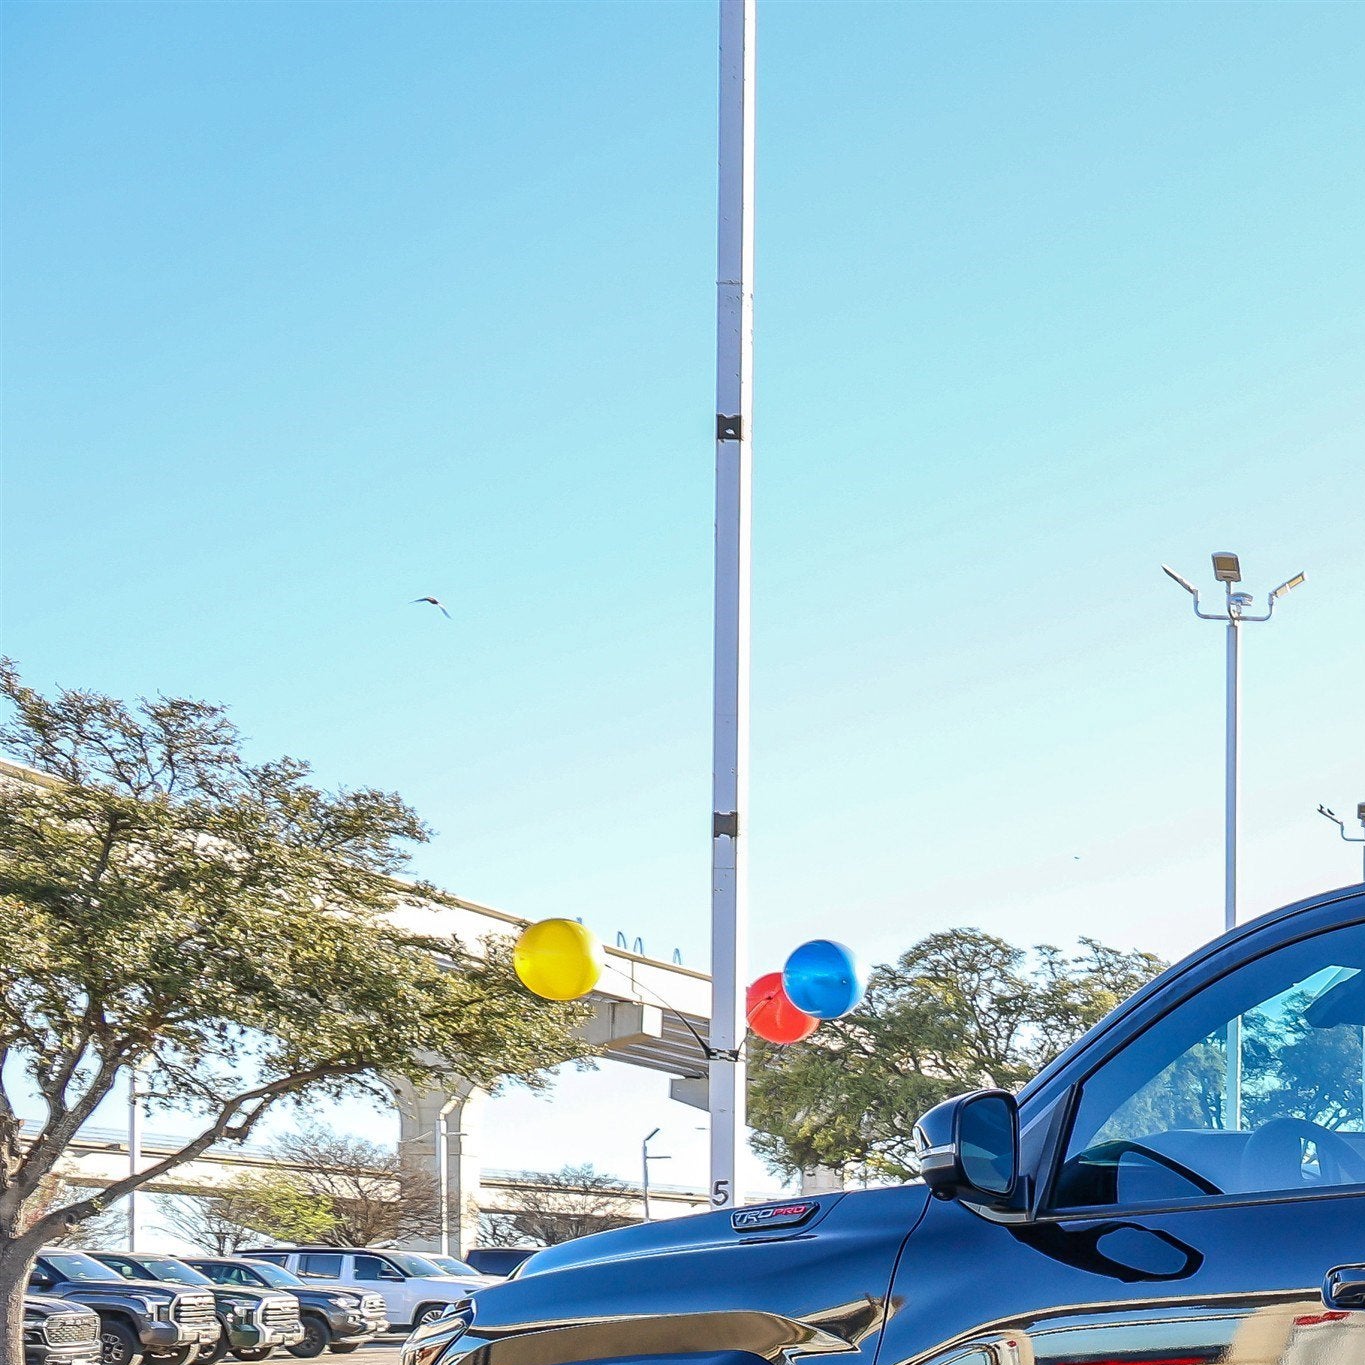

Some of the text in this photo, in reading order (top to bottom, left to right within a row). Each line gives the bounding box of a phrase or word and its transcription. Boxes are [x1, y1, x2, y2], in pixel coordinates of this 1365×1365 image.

[712, 1180, 729, 1206] 5
[734, 1205, 807, 1224] TRD PRO
